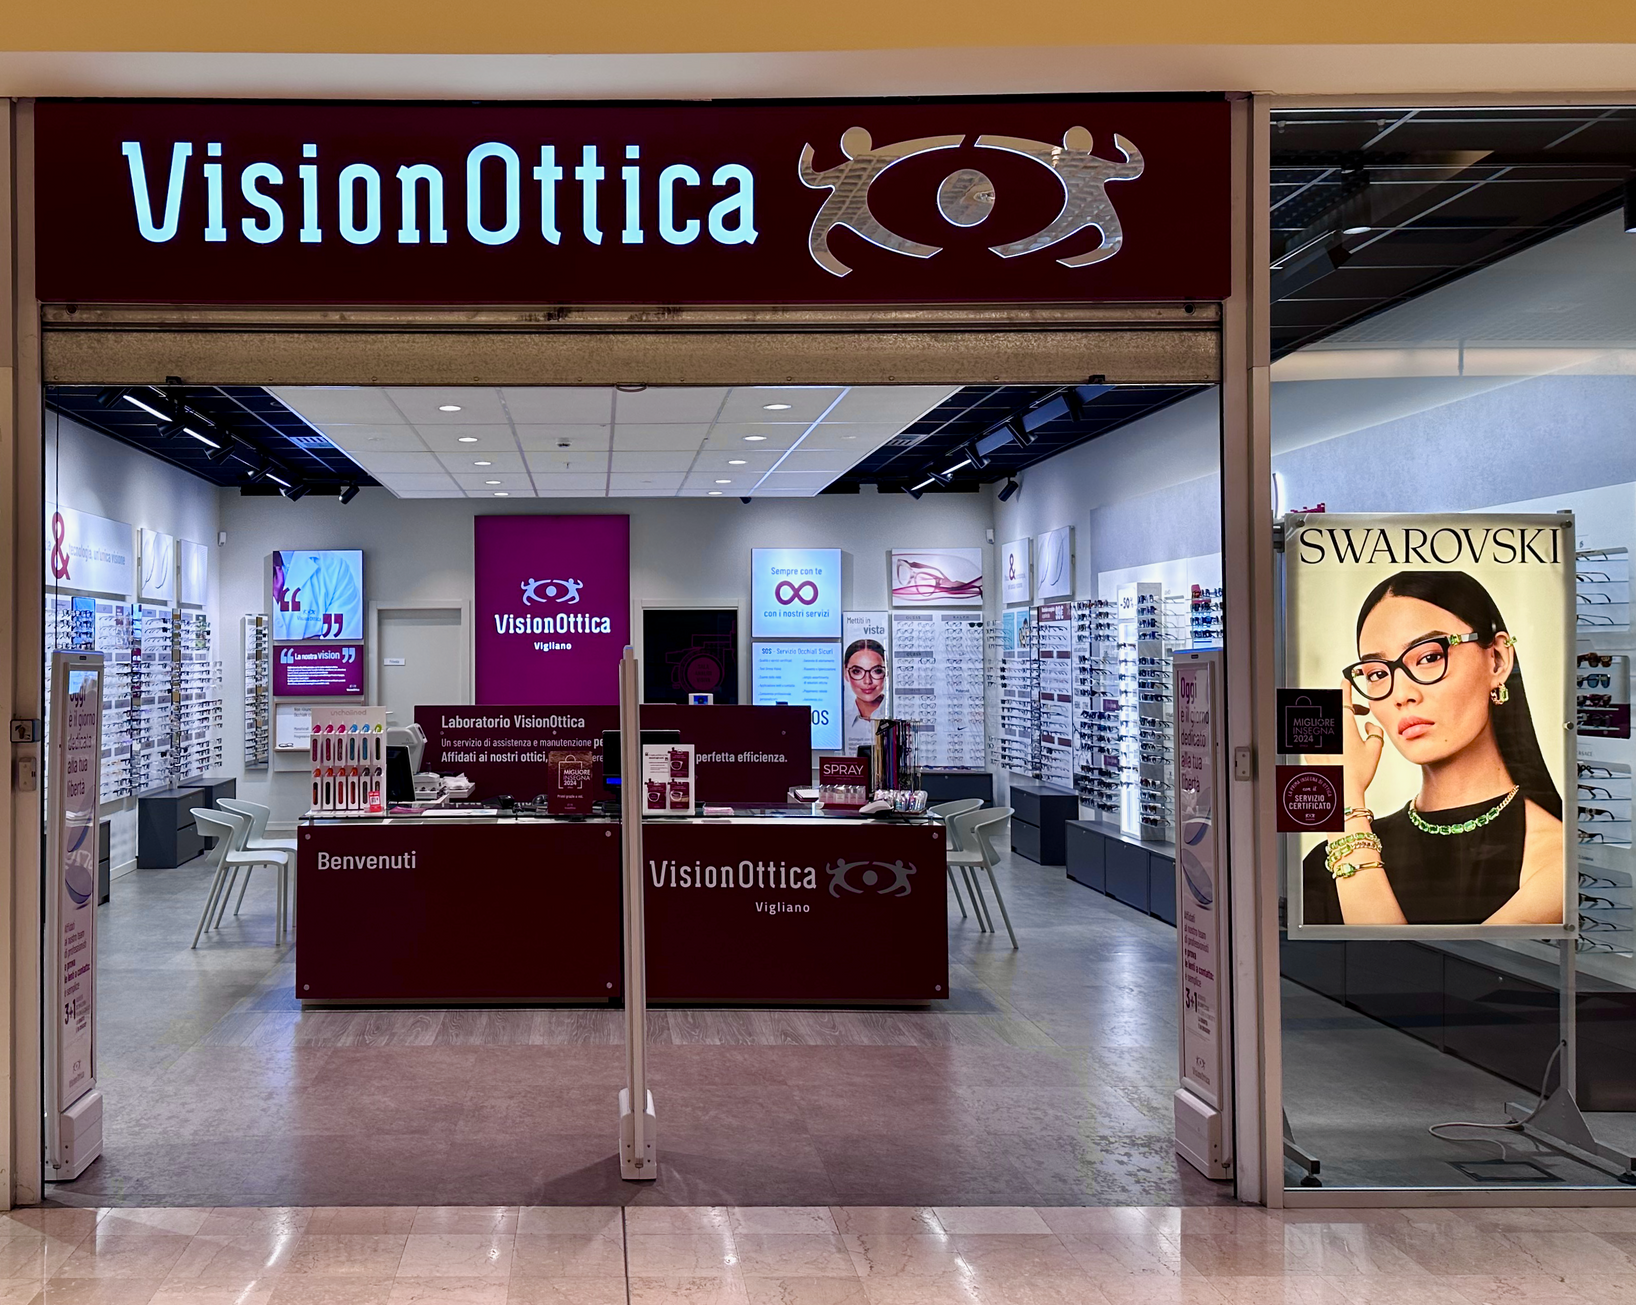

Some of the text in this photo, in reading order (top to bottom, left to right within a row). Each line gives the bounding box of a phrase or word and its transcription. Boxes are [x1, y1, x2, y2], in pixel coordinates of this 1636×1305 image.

[122, 141, 758, 245] VisionOttica
[1300, 528, 1561, 564] SWAROVSKI
[112, 550, 125, 566] visione
[771, 566, 798, 577] Sempre
[779, 609, 781, 617] i
[783, 609, 804, 617] nostri
[806, 609, 830, 617] servizi
[494, 613, 611, 634] VisionOttica
[864, 625, 885, 635] vista
[318, 650, 340, 660] vision
[534, 642, 572, 652] Vigliano
[1181, 676, 1197, 704] Oggi
[78, 710, 95, 731] giorno
[441, 715, 585, 728] Laboratorio VisionOttica
[1190, 706, 1209, 728] giorno
[1293, 718, 1335, 726] MIGLIORE
[1181, 728, 1206, 747] dedicato
[1293, 727, 1335, 735] INSEGNA
[68, 733, 91, 750] dedicato
[441, 739, 451, 747] Un
[453, 738, 482, 747] servizio
[484, 738, 491, 747] di
[493, 738, 532, 747] assistenza
[540, 738, 592, 747] manutenzione
[68, 756, 87, 774] alla tua
[441, 752, 476, 762] Affidati
[479, 752, 488, 762] ai
[490, 752, 518, 762] nostri
[521, 752, 548, 763] ottici,
[696, 752, 735, 764] perfetta
[737, 752, 788, 762] efficienza.
[1181, 751, 1202, 770] alla tua
[823, 764, 864, 775] SPRAY
[67, 778, 85, 797] libertà
[1182, 773, 1200, 792] libertà
[1290, 780, 1300, 791] PRIMA
[1322, 783, 1332, 797] OTTICA
[317, 850, 416, 870] Benvenuti
[650, 860, 816, 889] VisionOttica
[755, 902, 810, 915] Vigliano
[68, 934, 77, 944] nostro
[1188, 950, 1196, 960] prova
[67, 959, 75, 971] prova
[1188, 974, 1201, 987] semplice
[67, 982, 79, 996] semplice
[1186, 987, 1197, 1012] 3+1
[65, 999, 76, 1024] 3+1
